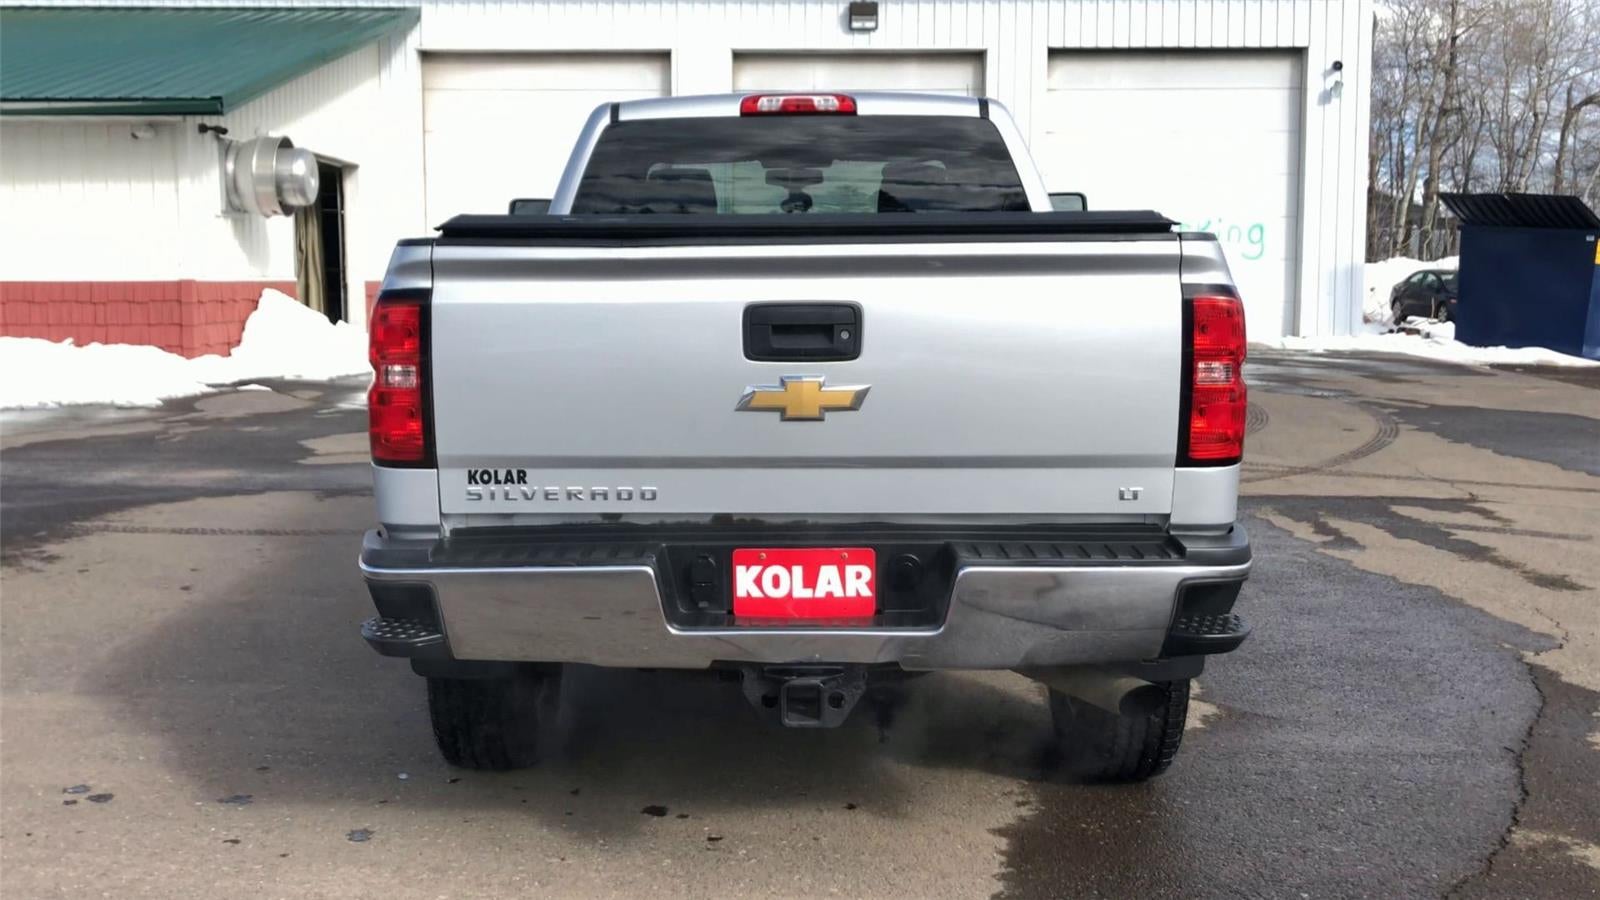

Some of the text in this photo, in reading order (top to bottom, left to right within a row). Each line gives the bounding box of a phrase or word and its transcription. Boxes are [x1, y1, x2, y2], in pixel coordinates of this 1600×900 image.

[467, 469, 527, 485] KOLAR
[466, 486, 658, 501] SILVERADO
[1118, 486, 1144, 501] LT
[735, 564, 873, 599] KOLAR
